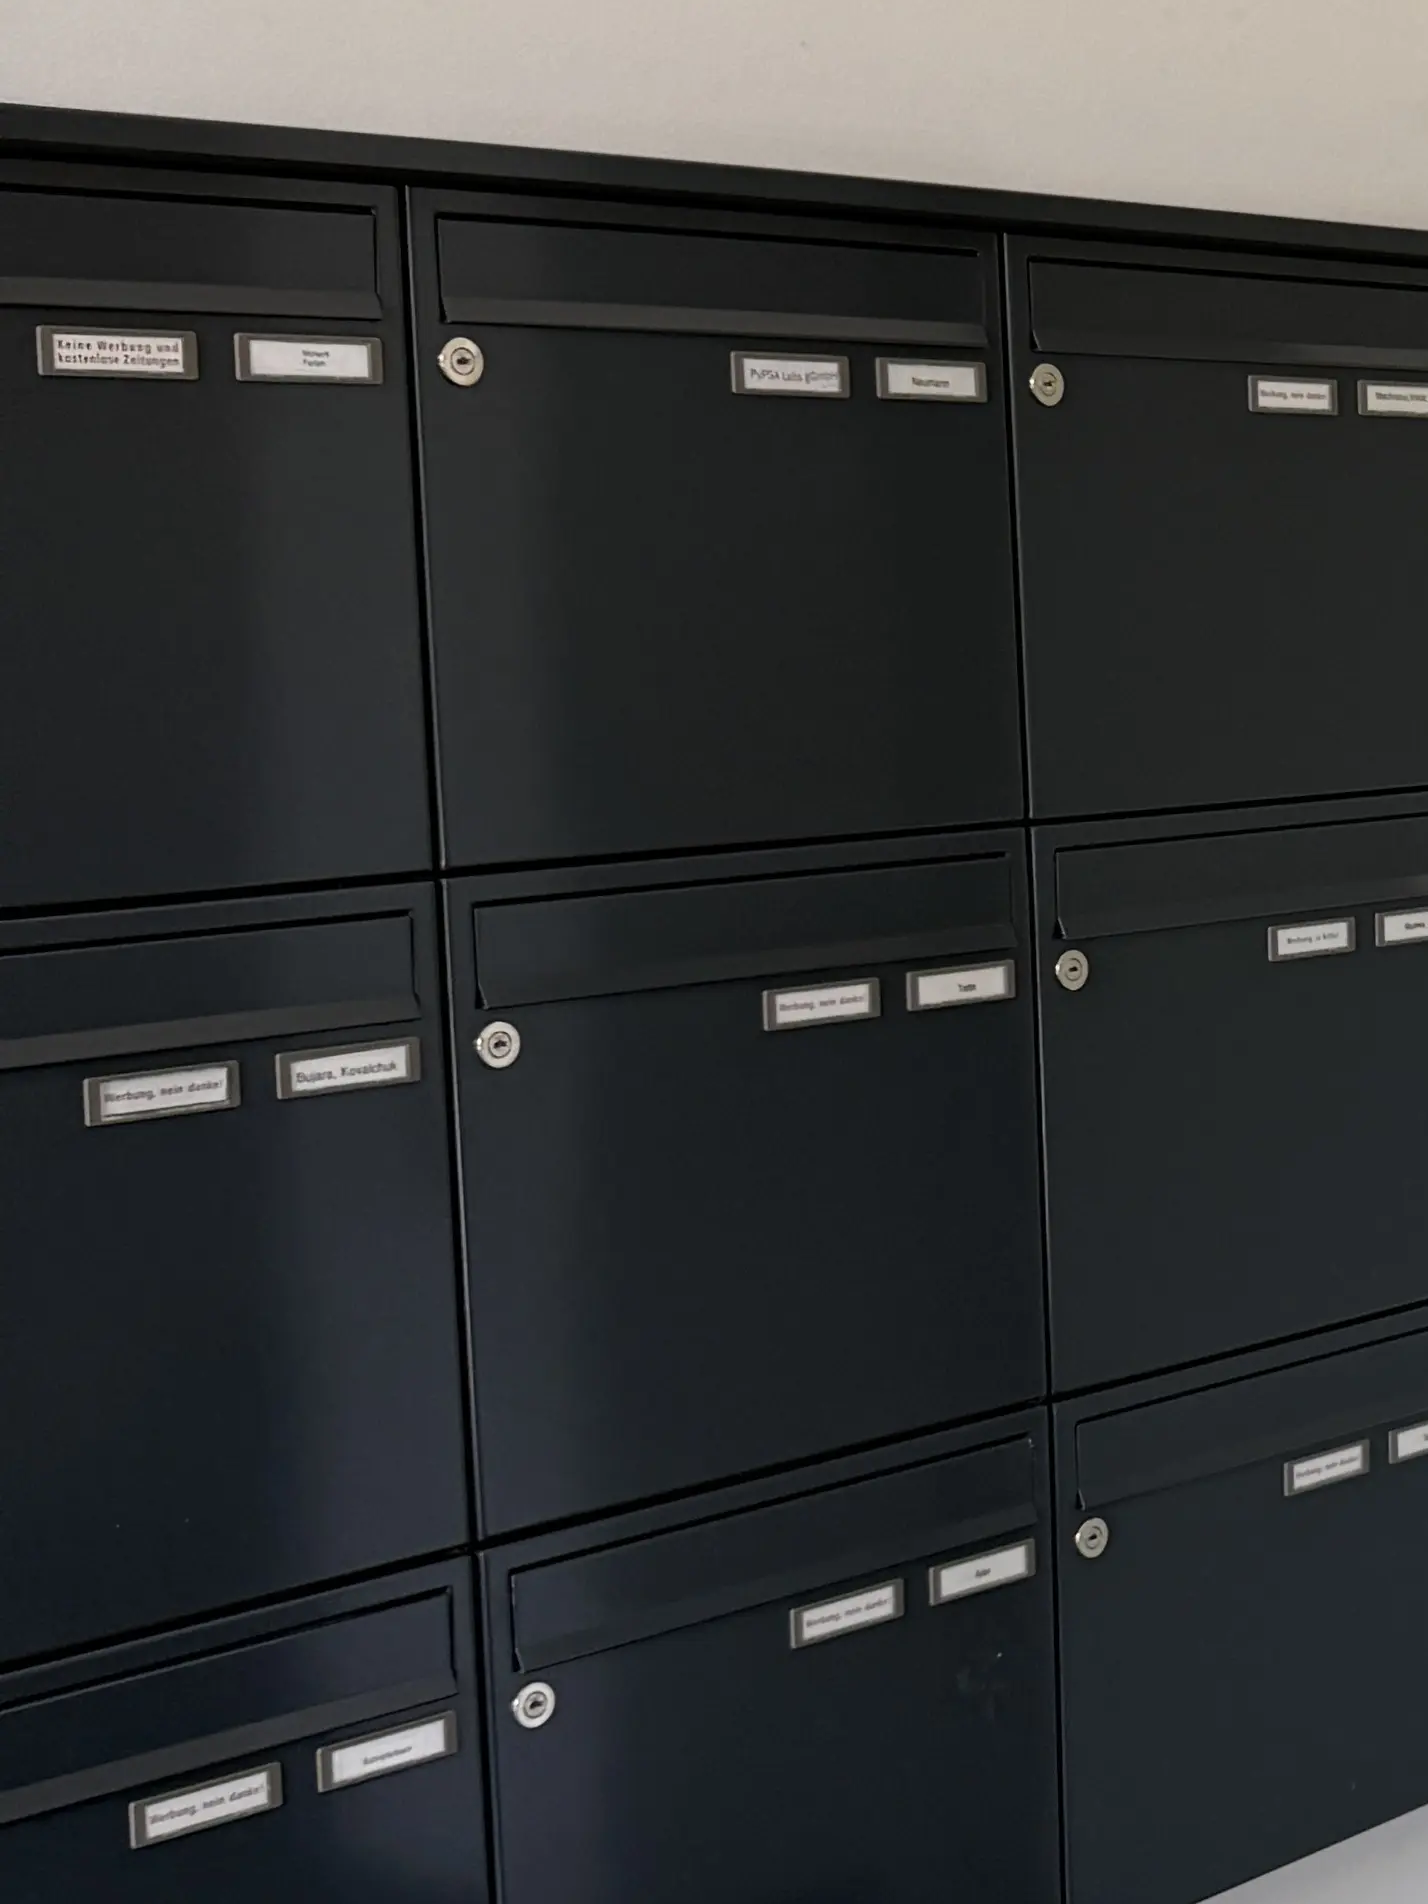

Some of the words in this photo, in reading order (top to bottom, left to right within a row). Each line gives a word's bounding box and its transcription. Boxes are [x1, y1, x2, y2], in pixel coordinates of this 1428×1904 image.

[57, 339, 92, 350] Keine
[97, 340, 152, 355] Werbung
[156, 342, 180, 353] und
[123, 354, 180, 369] Zeitungen
